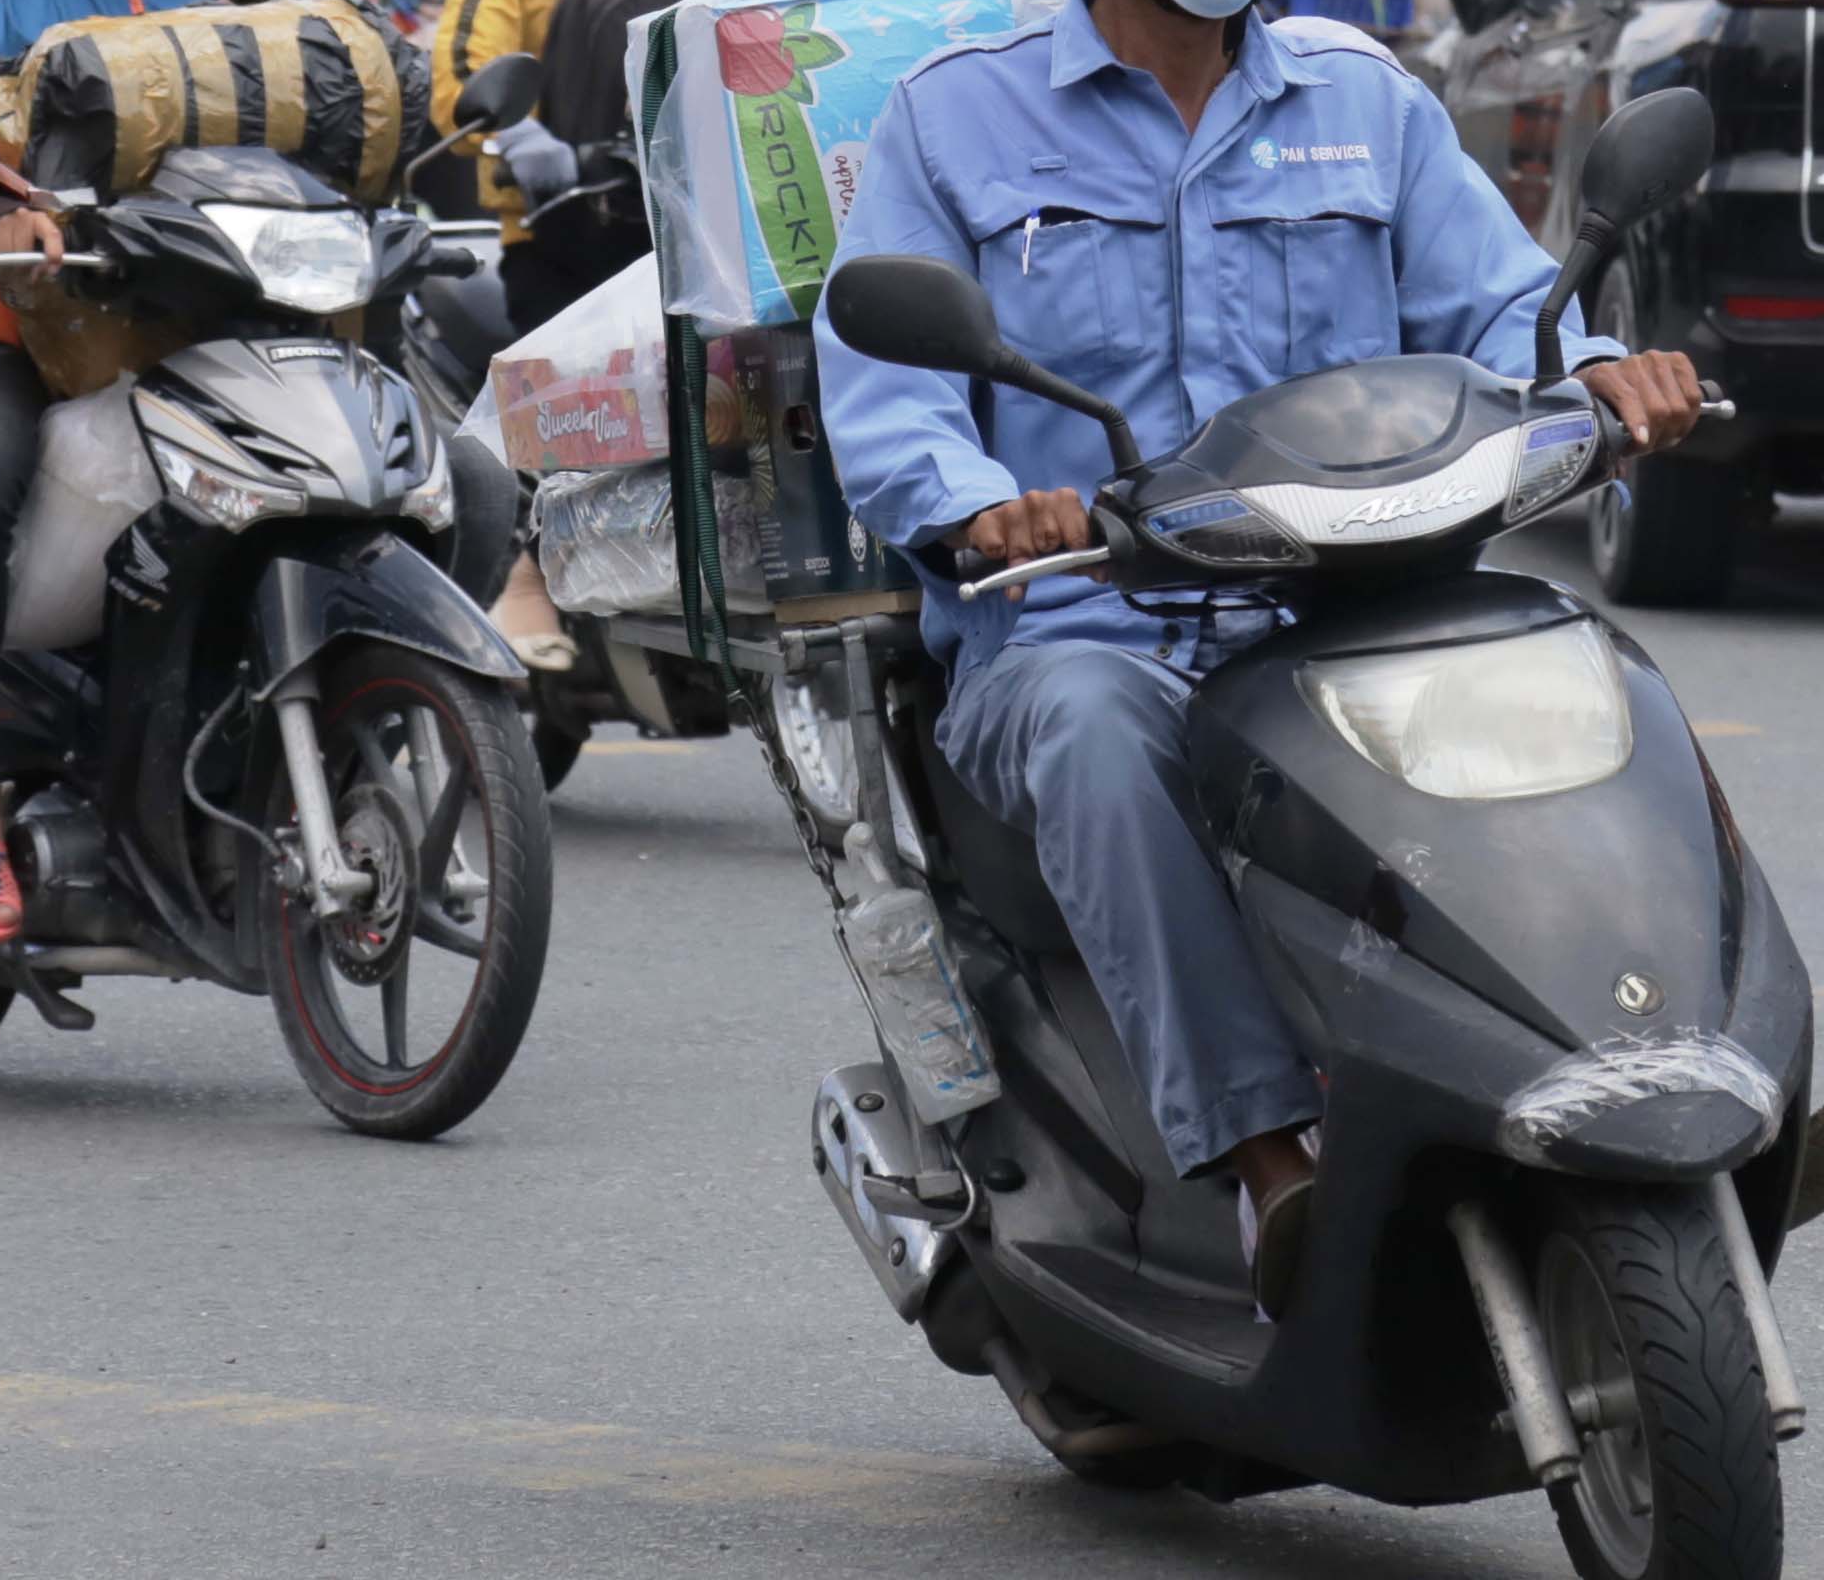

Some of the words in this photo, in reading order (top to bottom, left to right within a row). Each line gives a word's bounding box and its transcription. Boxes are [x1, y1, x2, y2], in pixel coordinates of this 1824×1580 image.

[1280, 147, 1306, 163] PAN
[1310, 144, 1371, 161] SERVICES
[1328, 478, 1481, 534] Attila
